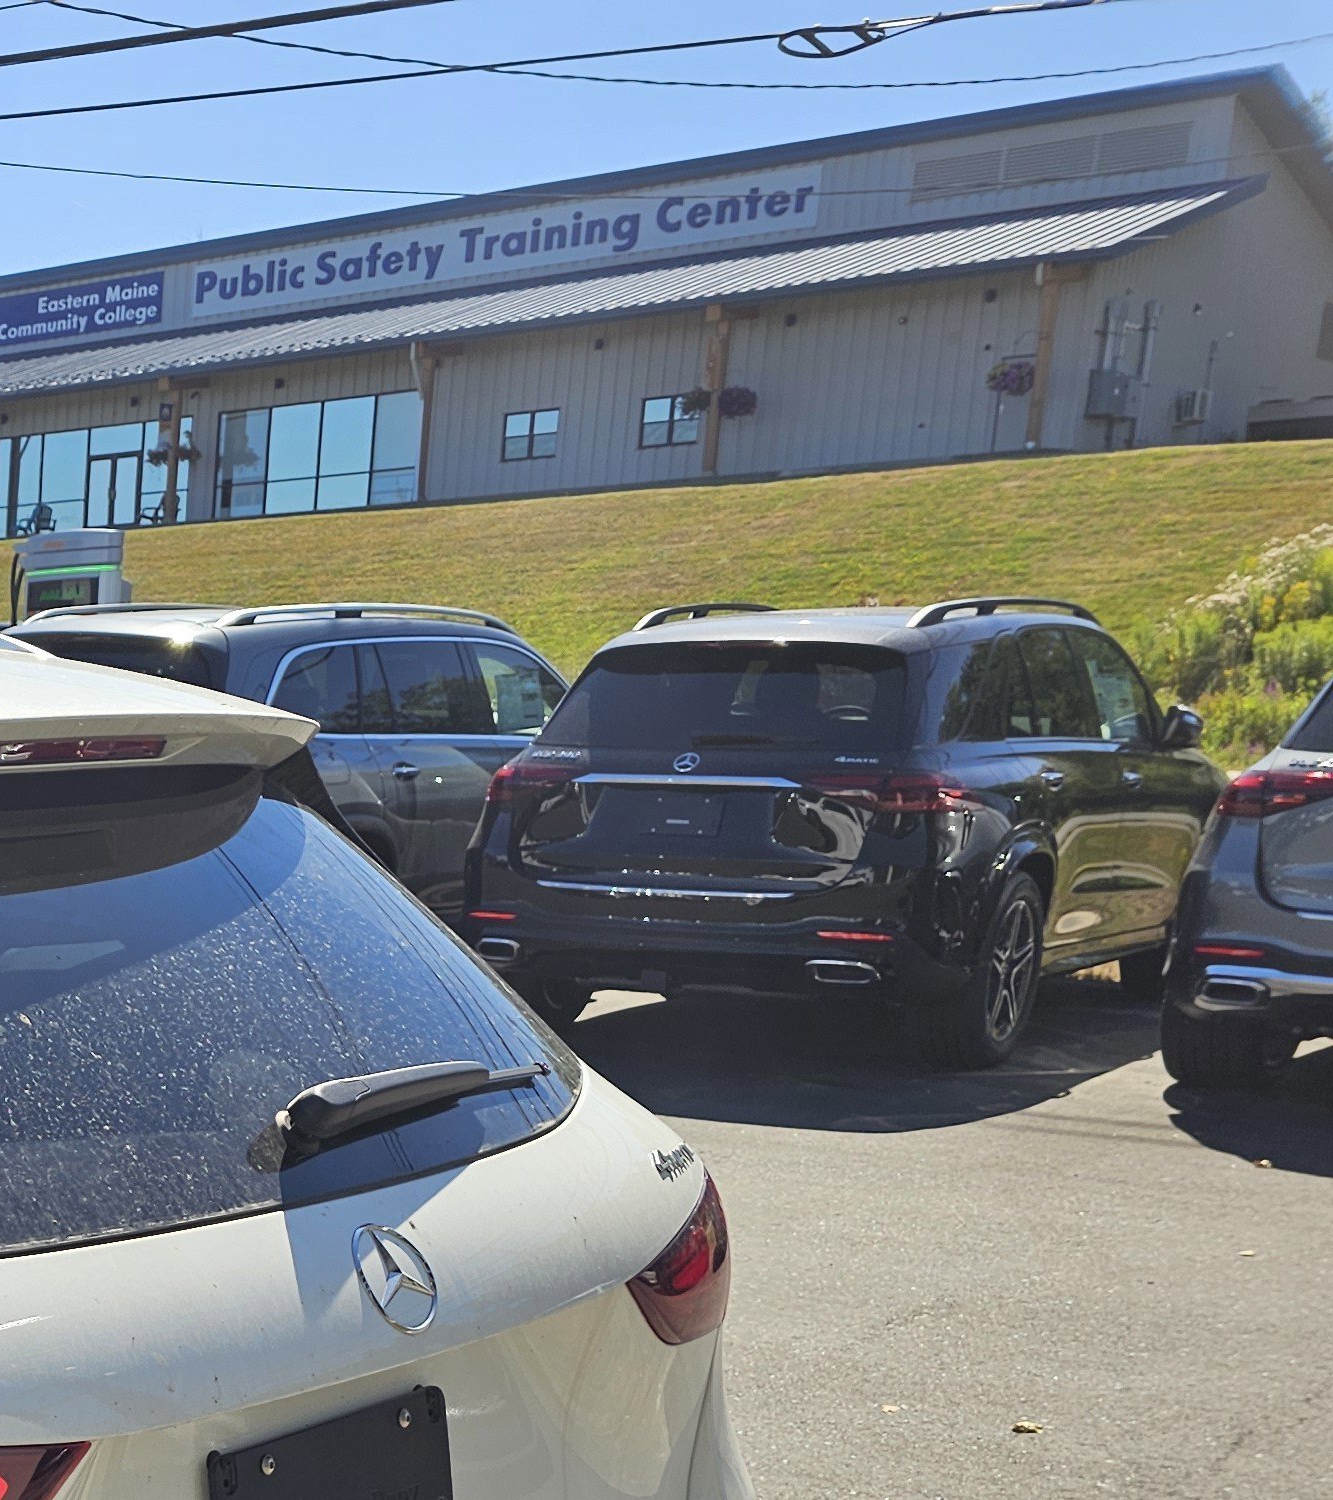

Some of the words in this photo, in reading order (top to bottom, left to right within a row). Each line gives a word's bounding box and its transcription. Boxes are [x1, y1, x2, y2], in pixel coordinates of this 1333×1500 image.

[195, 258, 305, 304] Public
[314, 241, 445, 285] Safety
[459, 211, 641, 263] Training
[656, 186, 814, 233] Center
[38, 293, 100, 314] Eastern
[105, 282, 159, 303] Maine
[94, 304, 158, 325] College
